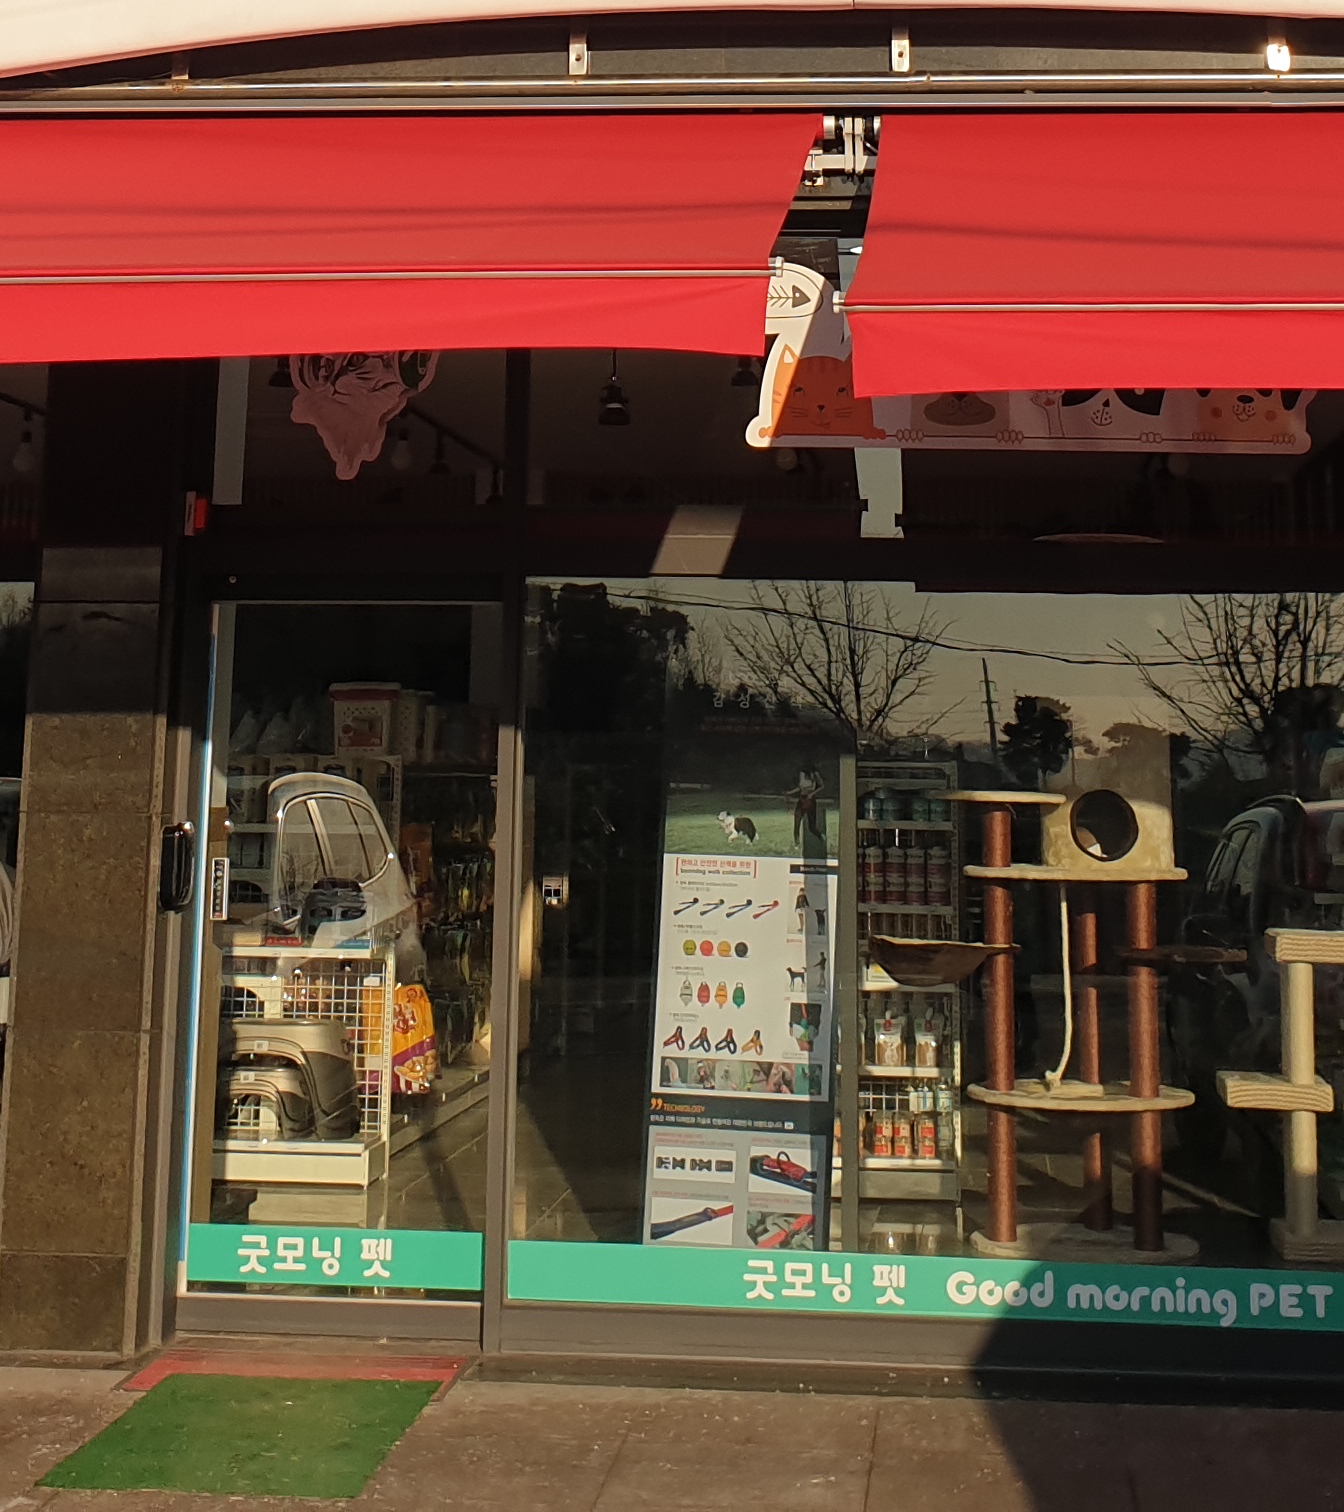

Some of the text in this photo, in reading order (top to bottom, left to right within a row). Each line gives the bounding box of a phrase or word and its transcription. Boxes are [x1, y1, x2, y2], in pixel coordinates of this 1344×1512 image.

[236, 1234, 394, 1280] 굿모닝 펫
[741, 1258, 909, 1310] 굿모닝 펫
[944, 1269, 1335, 1327] Good morning PET
